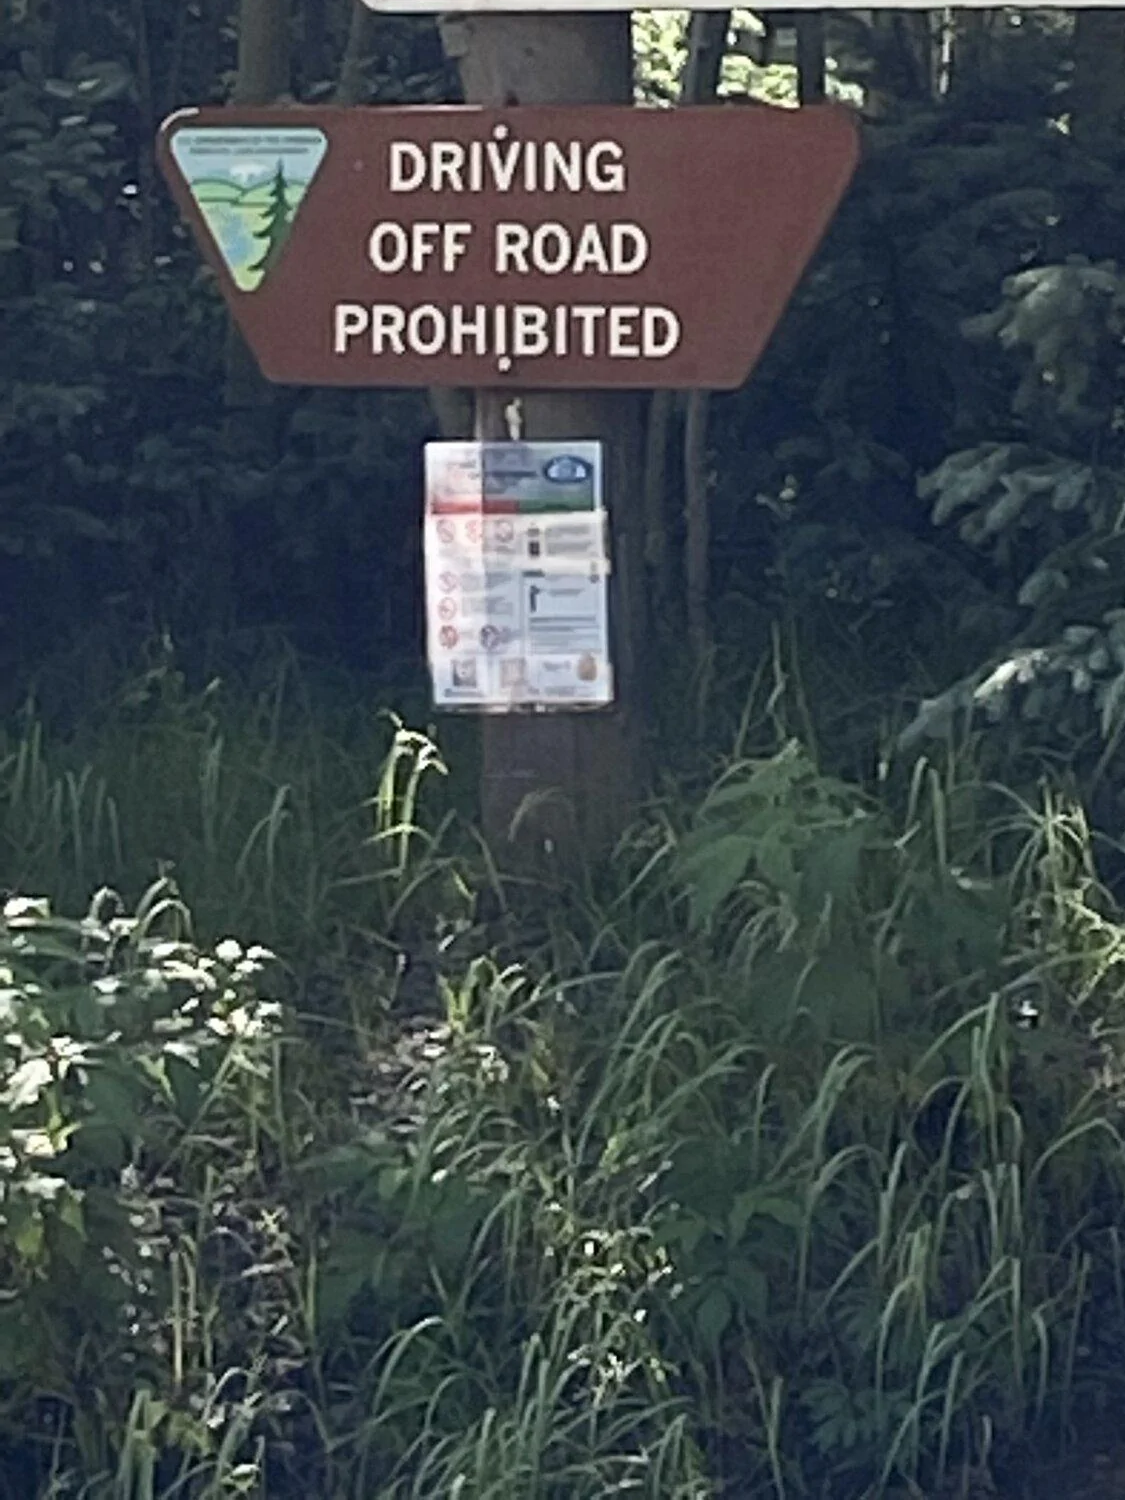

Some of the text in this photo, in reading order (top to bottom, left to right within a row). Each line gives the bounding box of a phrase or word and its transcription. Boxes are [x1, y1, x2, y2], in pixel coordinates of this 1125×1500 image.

[389, 140, 626, 193] DRIVING
[369, 222, 650, 275] OFF ROAD
[335, 304, 682, 358] PROHIBITED
